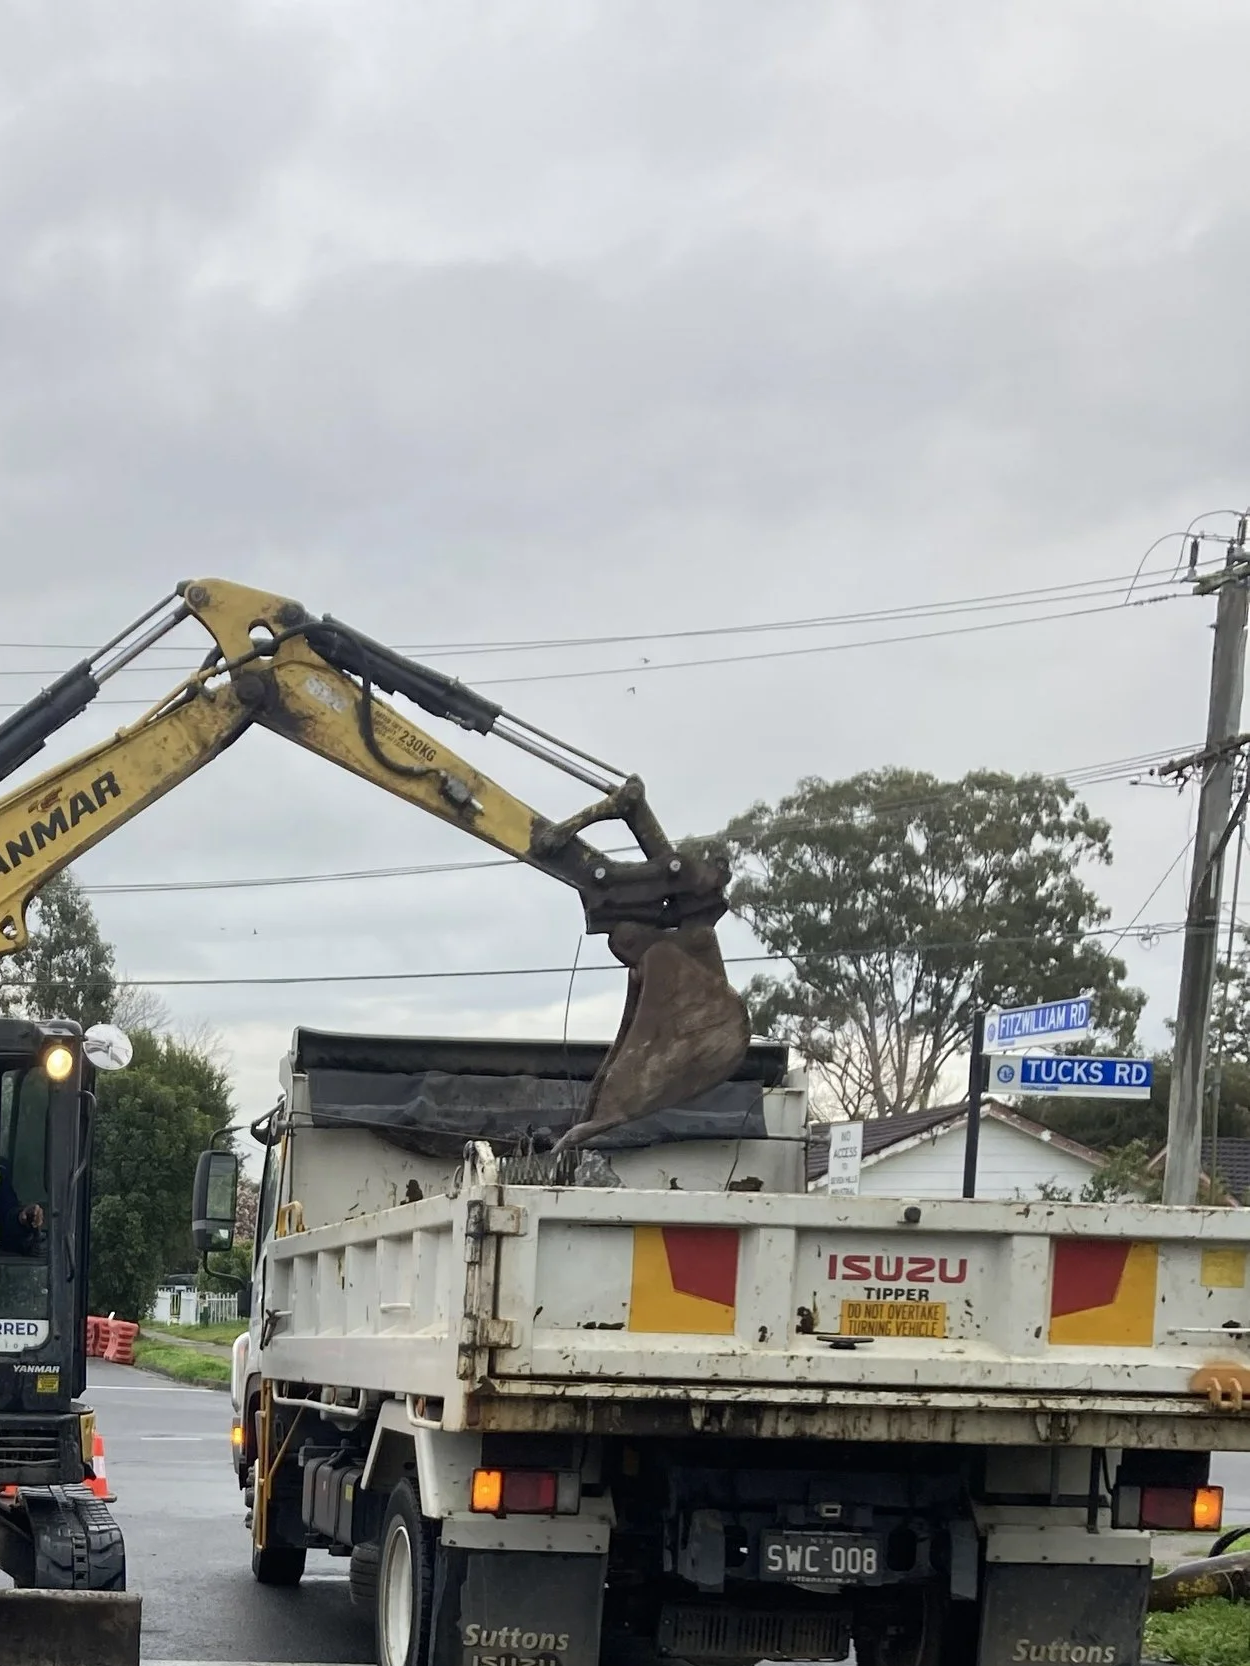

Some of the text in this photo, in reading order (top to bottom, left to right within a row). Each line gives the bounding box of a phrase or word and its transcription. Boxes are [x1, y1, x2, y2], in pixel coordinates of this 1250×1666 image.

[400, 731, 437, 762] 230KG
[1000, 1002, 1087, 1037] FITZWILLIAM RD
[1027, 1060, 1147, 1084] TUCKS RD
[841, 1131, 851, 1141] NO
[834, 1147, 858, 1158] ACCESS
[828, 1254, 967, 1284] ISUZU
[864, 1287, 930, 1301] TIPPER
[847, 1303, 940, 1320] DO NOT OVERTAKE
[848, 1320, 938, 1337] TURNING VEHICLE
[13, 1365, 60, 1373] YANMAR
[463, 1624, 569, 1651] Suttons
[1012, 1638, 1116, 1663] Suttons
